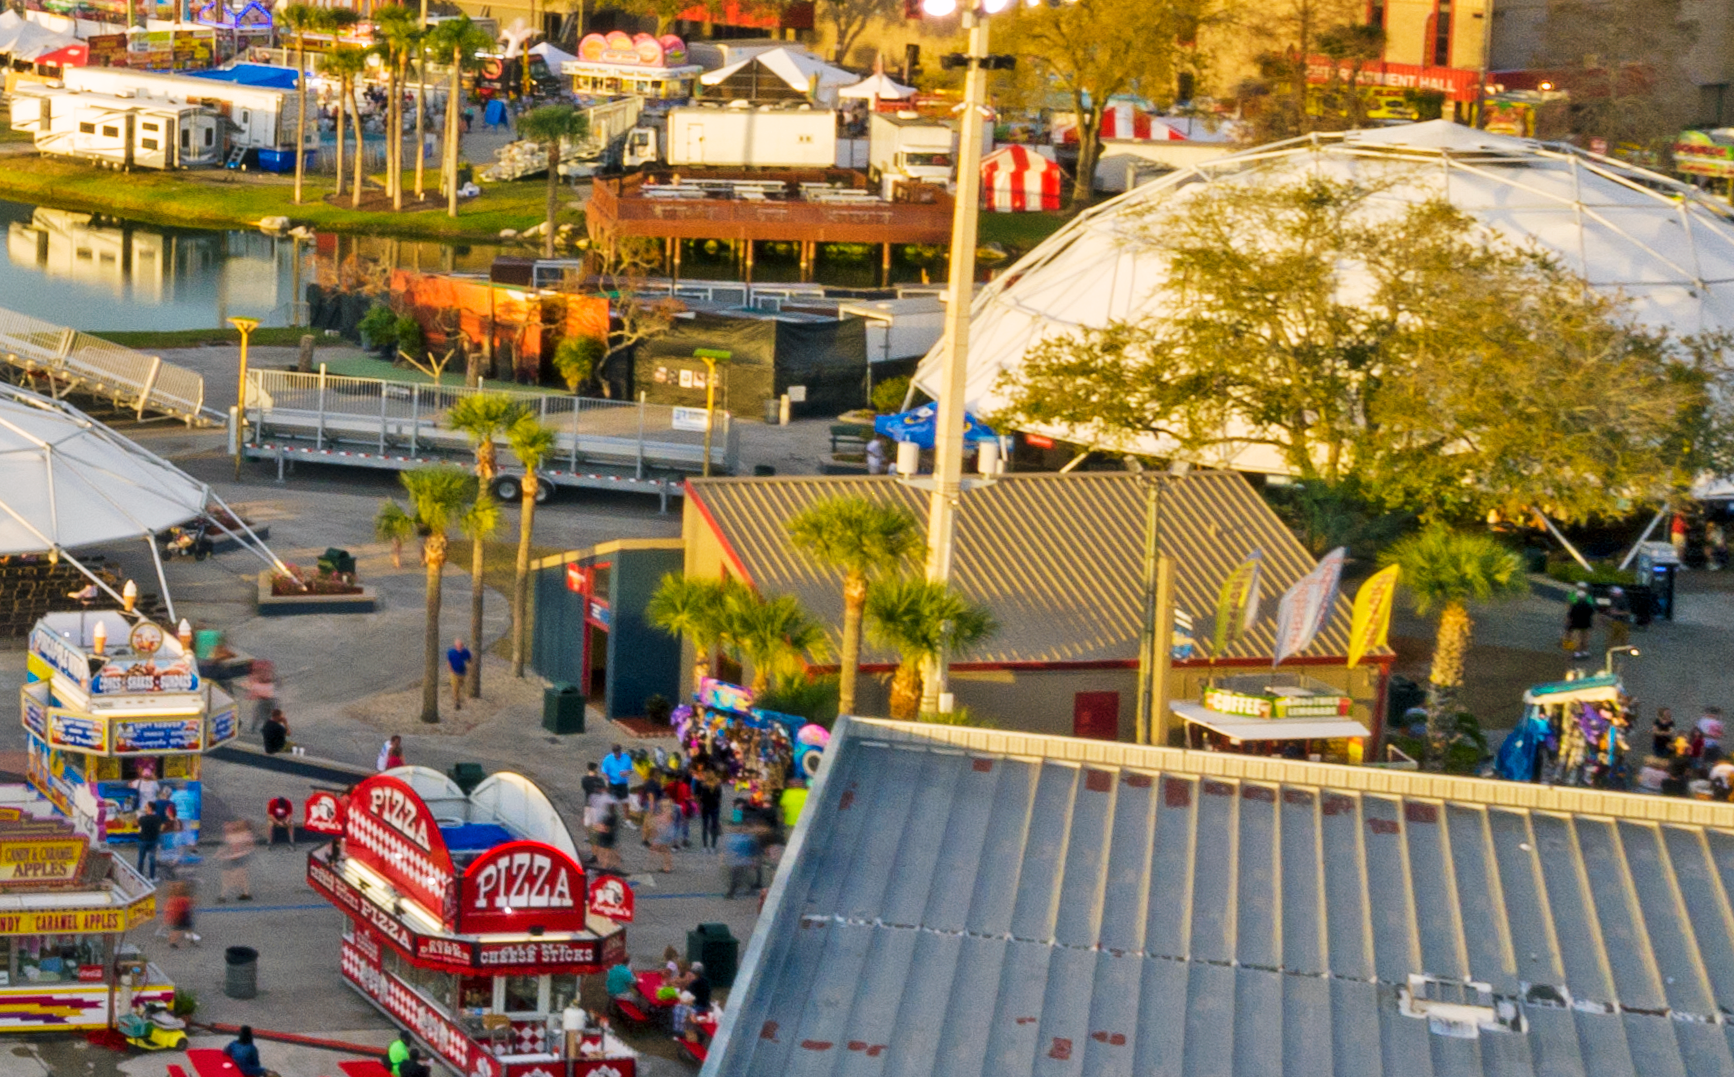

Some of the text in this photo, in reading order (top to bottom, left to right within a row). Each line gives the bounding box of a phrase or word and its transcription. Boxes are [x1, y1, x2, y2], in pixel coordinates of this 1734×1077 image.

[1419, 74, 1456, 92] HALL
[1213, 690, 1262, 716] COFFEE
[369, 786, 431, 852] PIZZA
[5, 845, 31, 863] CANDY
[39, 844, 76, 862] CARAMEL
[13, 862, 68, 878] APPLES
[475, 852, 574, 909] PIZZA
[34, 914, 81, 931] CARAMEL
[83, 913, 119, 930] APPLES
[360, 897, 412, 952] PIZZA
[480, 947, 594, 964] CHEESE STICKS
